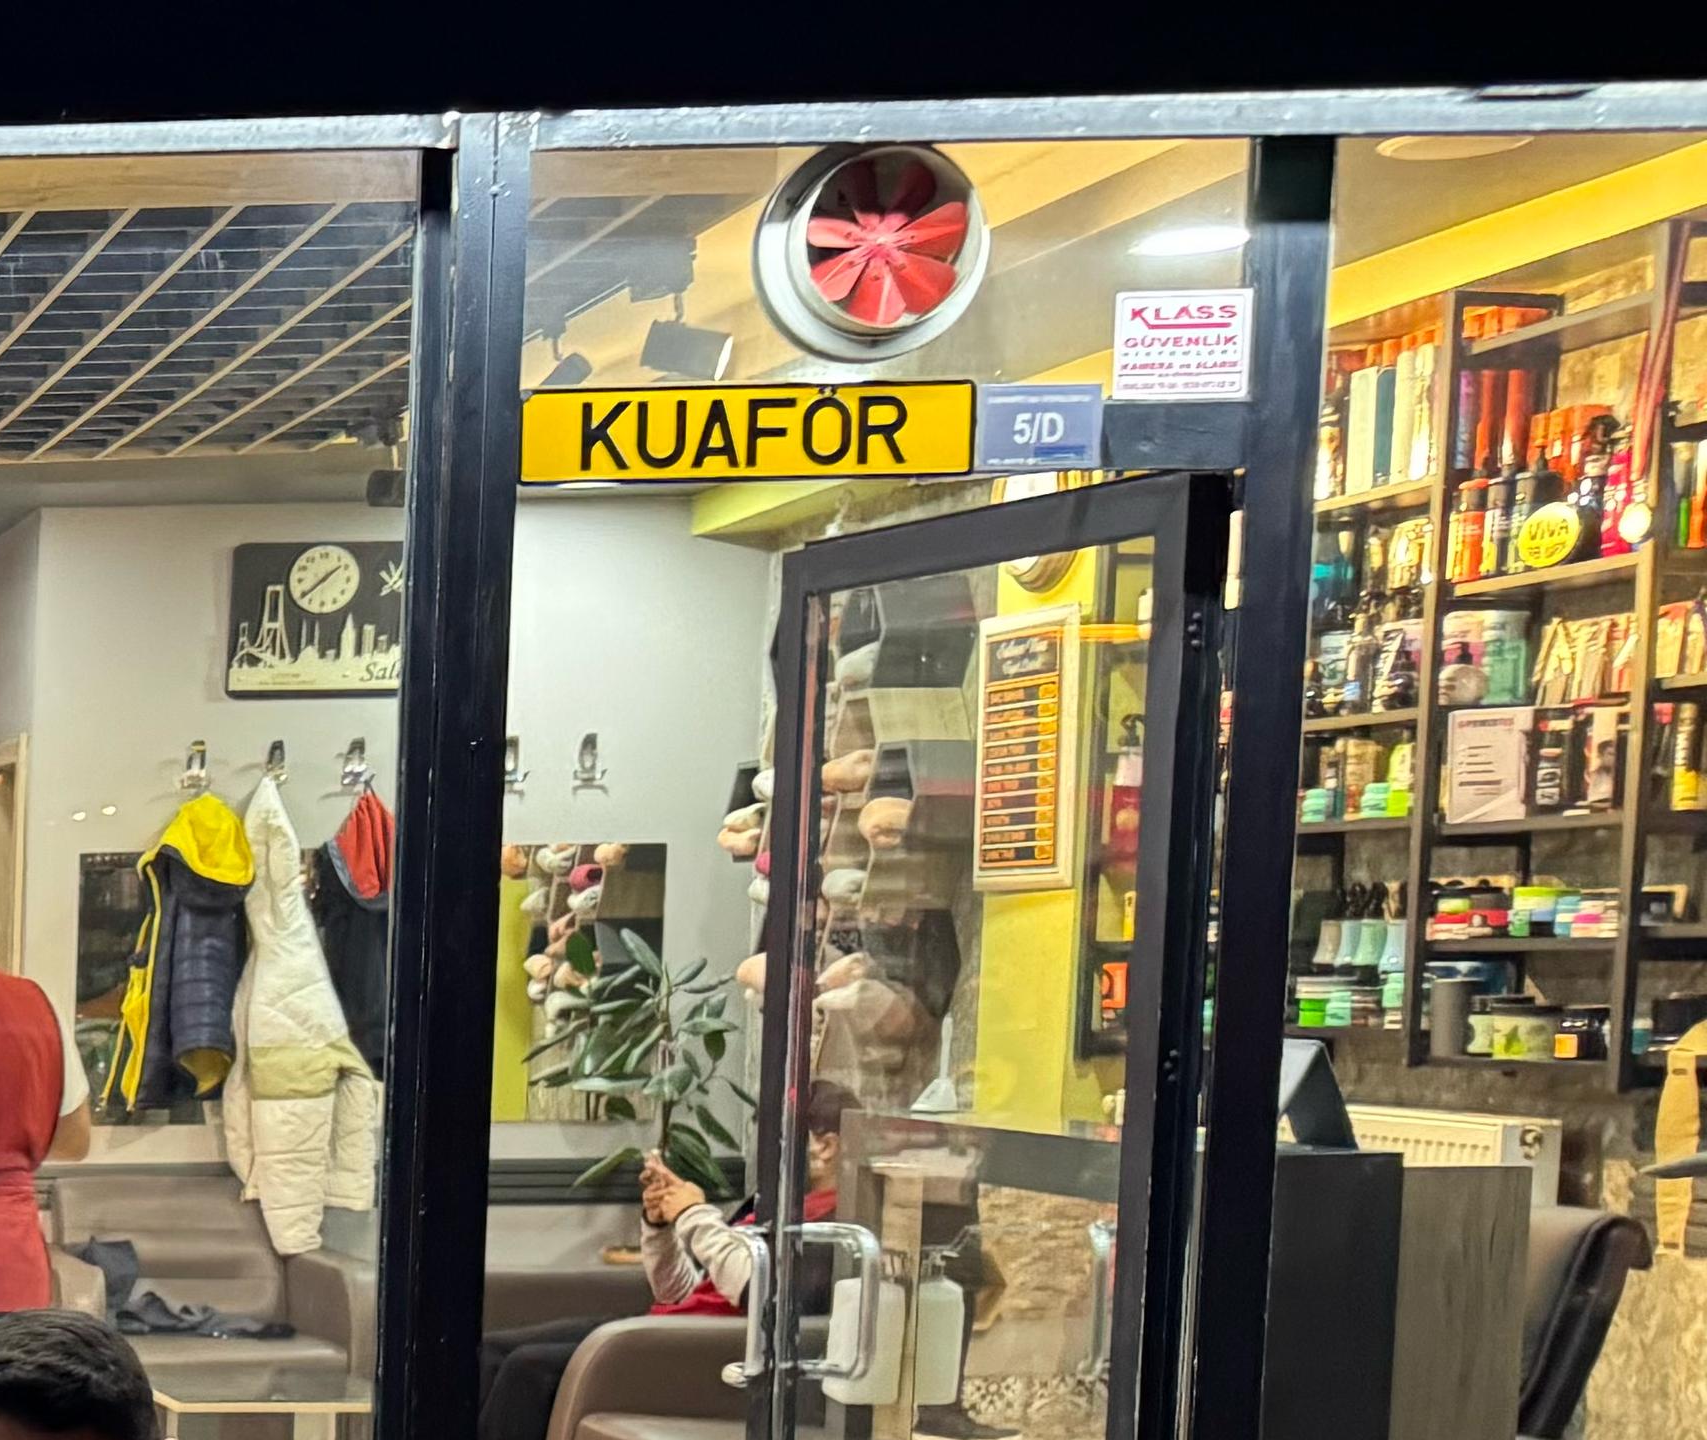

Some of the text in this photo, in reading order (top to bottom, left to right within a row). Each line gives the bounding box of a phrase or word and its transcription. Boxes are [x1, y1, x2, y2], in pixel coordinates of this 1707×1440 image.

[1130, 305, 1237, 327] KLASS
[580, 386, 908, 471] KUAFÖR
[1013, 411, 1064, 444] 5/D
